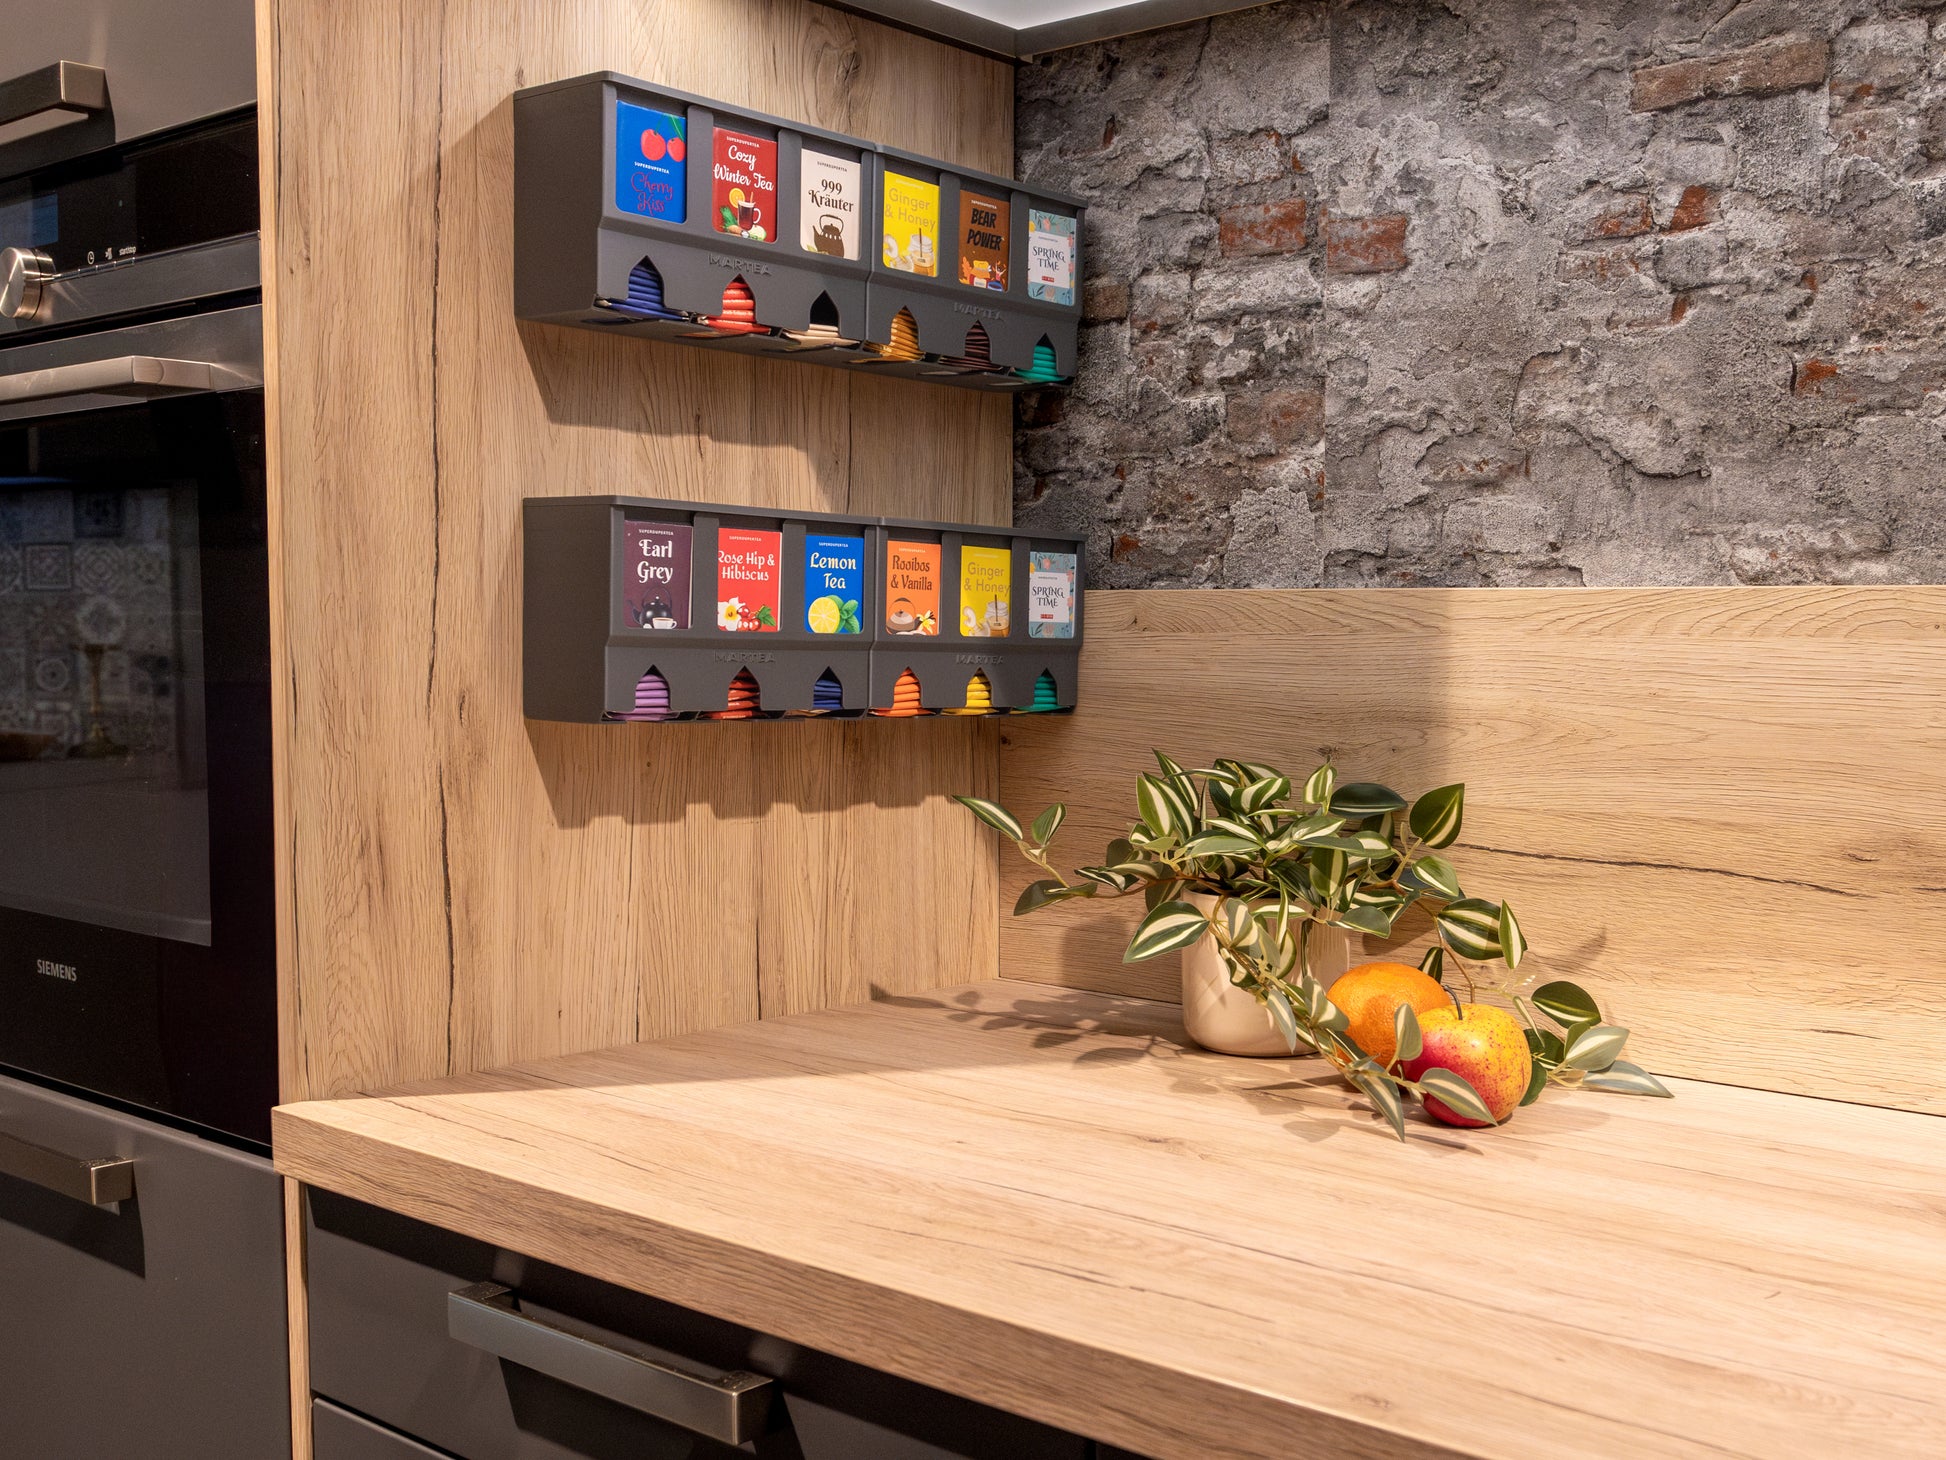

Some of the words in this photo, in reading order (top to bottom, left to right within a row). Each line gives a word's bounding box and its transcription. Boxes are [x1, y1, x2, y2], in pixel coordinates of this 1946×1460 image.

[728, 145, 756, 171] Cozy
[631, 171, 673, 201] Cherry
[713, 163, 751, 186] Winter
[753, 172, 774, 191] Tea
[821, 179, 843, 196] 999
[637, 191, 665, 217] Kiss
[808, 189, 854, 213] Kräuter
[889, 187, 930, 212] Ginger
[884, 203, 893, 218] &
[898, 206, 936, 233] Honey
[971, 207, 997, 229] BEAR
[966, 228, 1002, 251] POWER
[1032, 245, 1066, 263] SPRING
[708, 252, 771, 277] MARTEA
[1037, 257, 1060, 272] TIME
[638, 539, 673, 558] Earl
[718, 550, 744, 565] Rose
[745, 550, 765, 570] Hip
[767, 553, 775, 567] &
[810, 552, 857, 570] Lemon
[892, 554, 931, 572] Rooibos
[637, 560, 673, 584] Grey
[722, 564, 769, 581] Hibiscus
[823, 572, 846, 589] Tea
[967, 561, 1005, 581] Ginger
[890, 574, 899, 589] &
[901, 574, 933, 591] Vanilla
[963, 577, 972, 591] &
[975, 578, 1011, 598] Honey
[1032, 585, 1065, 599] SPRING
[1036, 596, 1059, 609] TIME
[713, 650, 776, 664] MARTEA
[36, 958, 78, 982] SIEMENS
